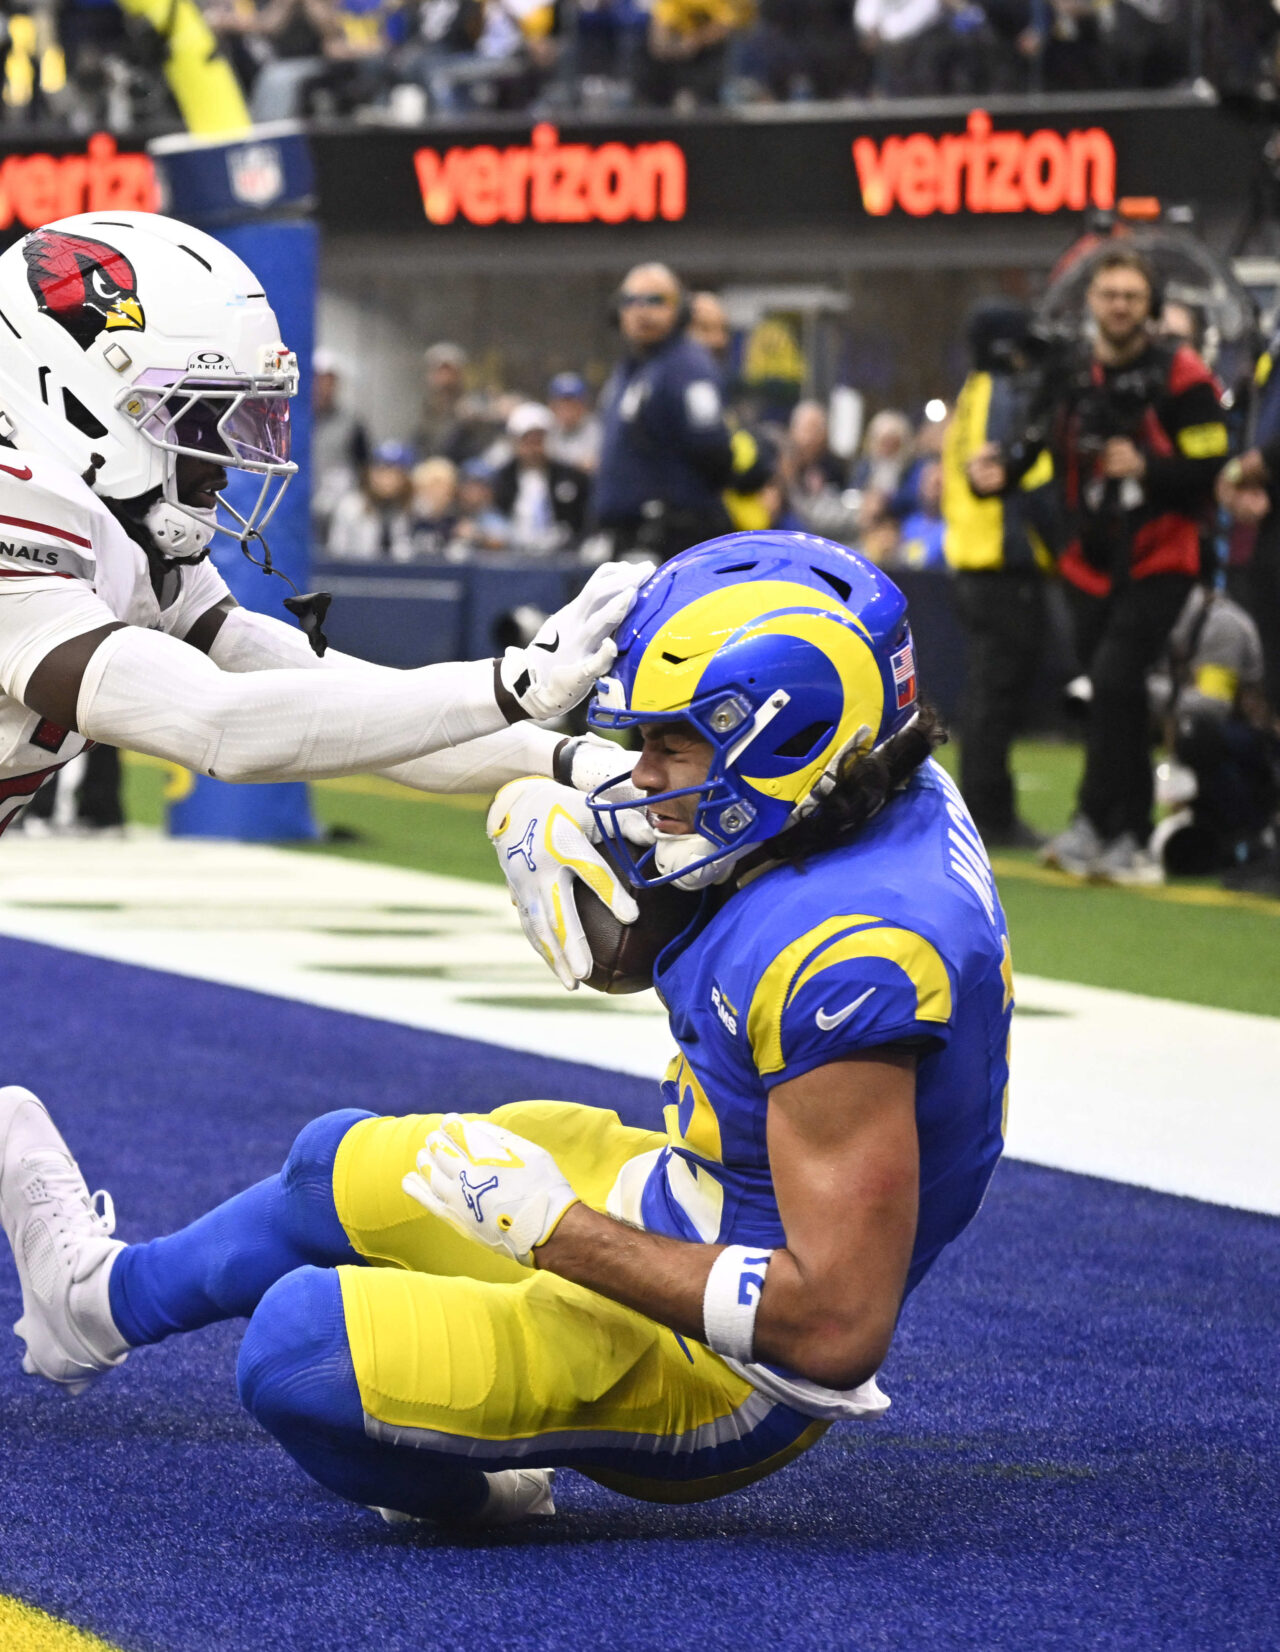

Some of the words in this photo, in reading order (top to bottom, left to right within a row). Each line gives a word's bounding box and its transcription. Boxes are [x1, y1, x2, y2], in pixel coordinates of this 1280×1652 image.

[413, 121, 687, 227] verizon
[852, 108, 1117, 216] verizon
[189, 363, 230, 371] OAKLEY
